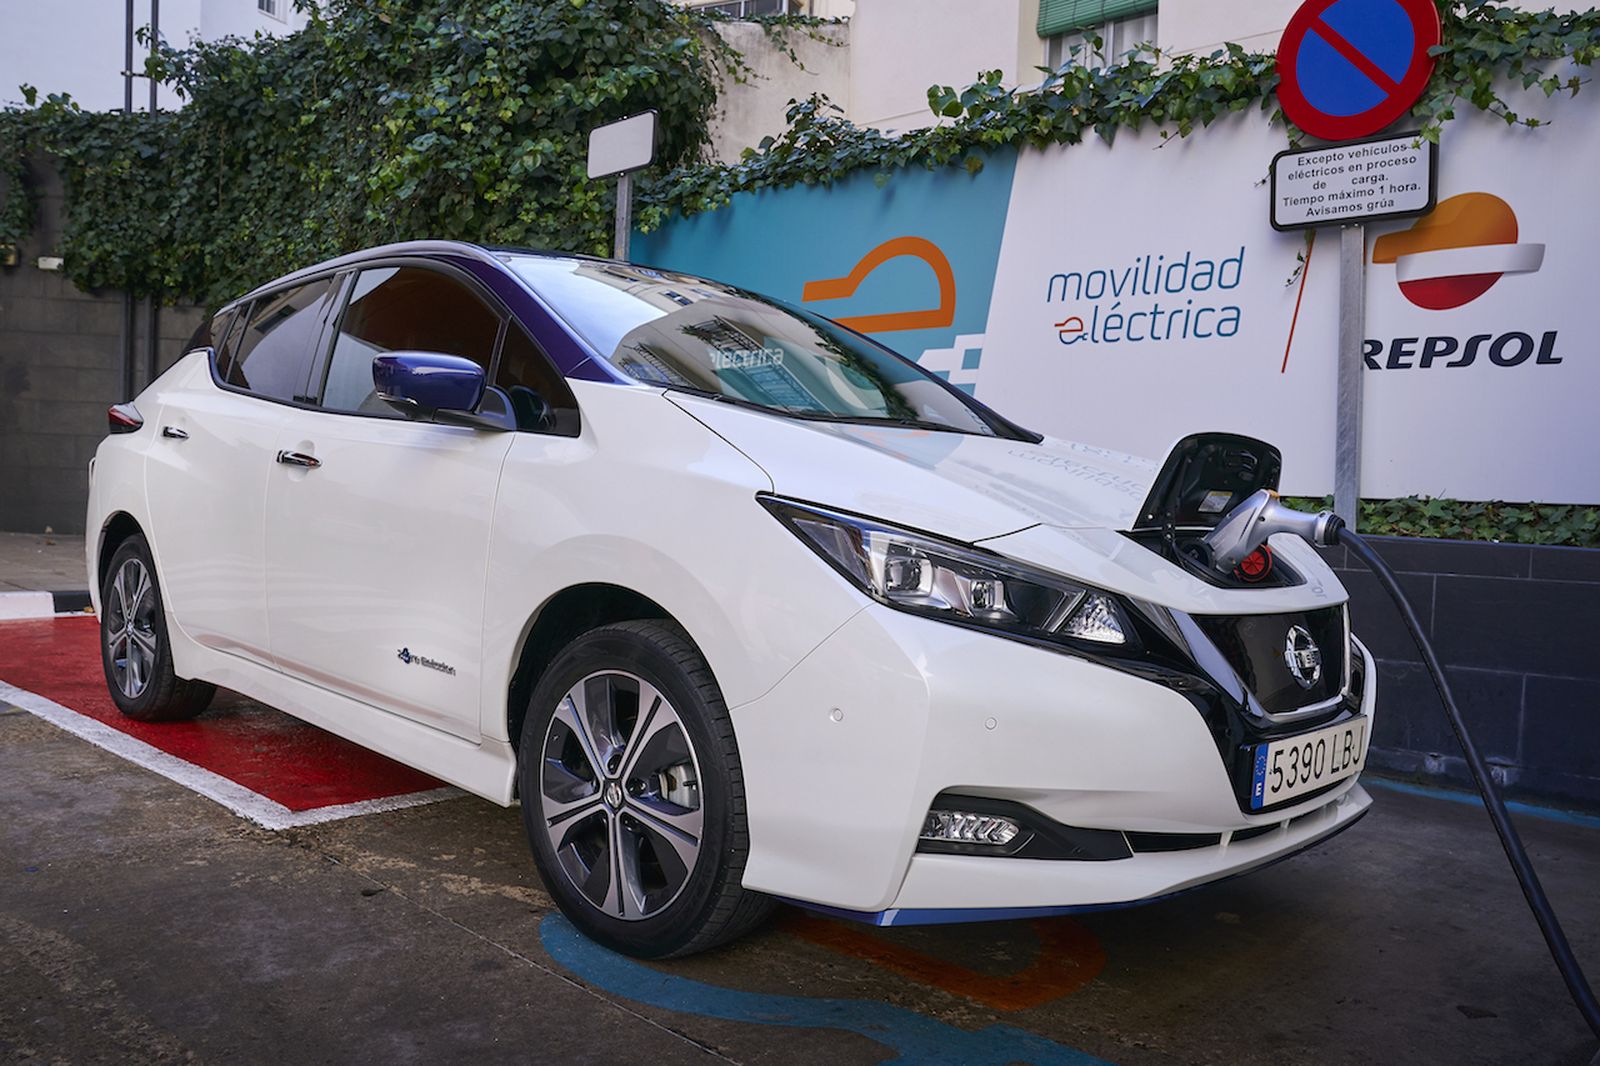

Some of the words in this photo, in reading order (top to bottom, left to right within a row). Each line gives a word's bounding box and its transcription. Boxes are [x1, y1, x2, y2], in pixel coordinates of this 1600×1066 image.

[1298, 153, 1345, 167] Excepto
[1347, 142, 1408, 159] vehículos
[1288, 164, 1345, 181] eléctricos
[1348, 164, 1363, 173] en
[1366, 155, 1417, 172] proceso
[1313, 180, 1327, 190] de
[1351, 173, 1389, 185] carga.
[1283, 195, 1325, 207] Tiempo
[1328, 187, 1375, 202] máximo
[1379, 185, 1384, 195] 1
[1389, 182, 1421, 194] hora.
[1306, 203, 1363, 217] Avisamos
[1366, 197, 1395, 212] grúa
[1046, 245, 1245, 303] movilidad
[1054, 299, 1241, 345] eléctrica
[1362, 330, 1564, 371] REPSOL
[1270, 738, 1326, 794] 5390
[1330, 725, 1365, 775] LBJ
[1255, 782, 1263, 797] E
